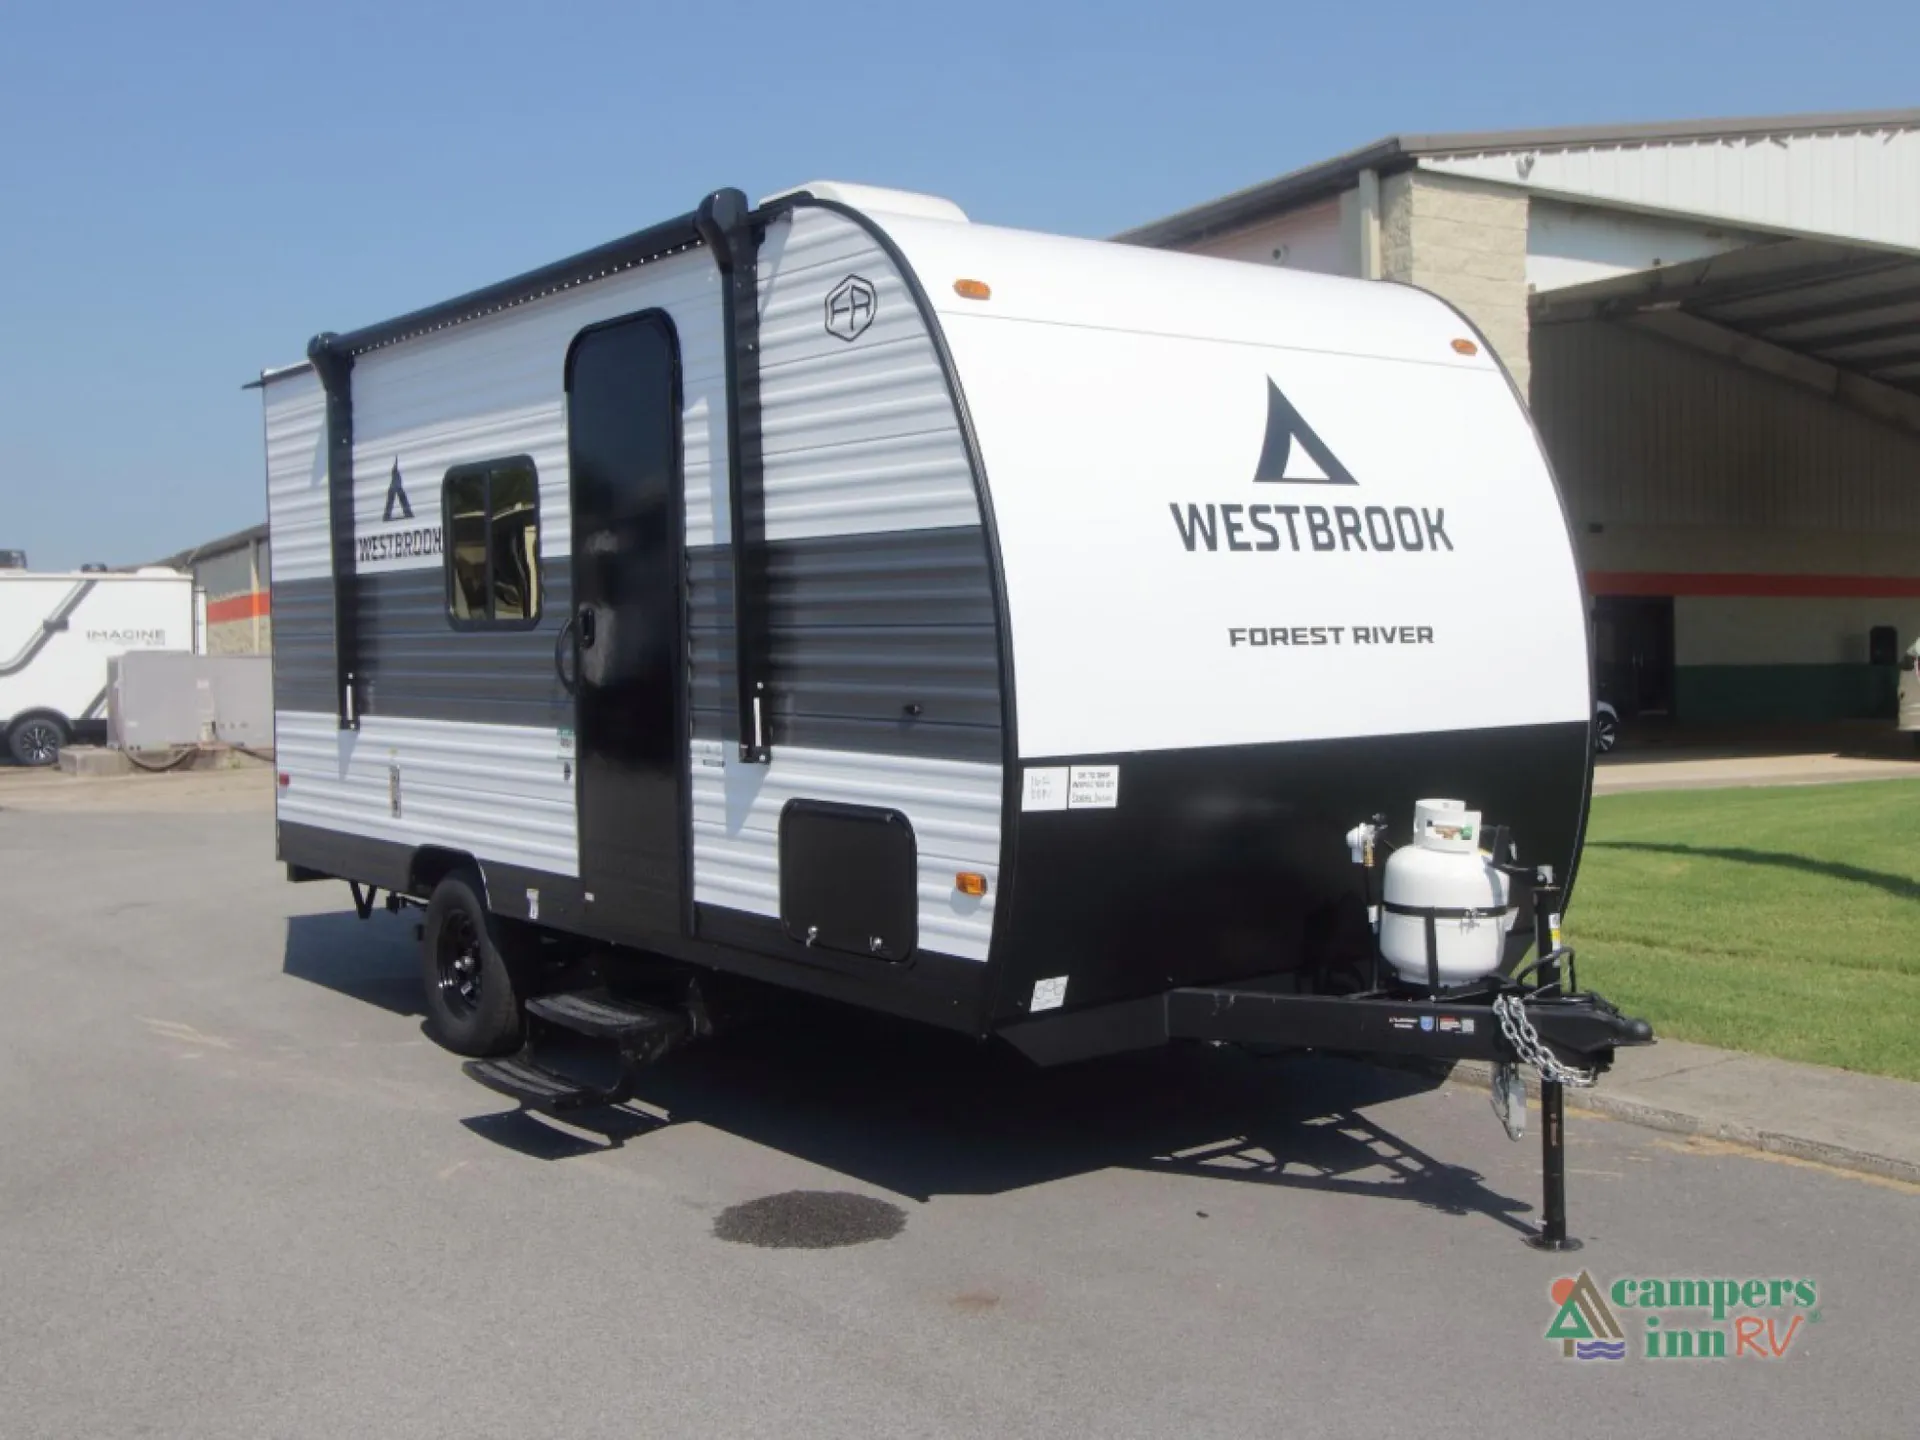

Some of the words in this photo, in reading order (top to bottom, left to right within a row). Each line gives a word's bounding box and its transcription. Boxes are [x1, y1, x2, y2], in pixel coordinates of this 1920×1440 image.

[1169, 502, 1454, 552] WESTBROOK
[358, 527, 443, 562] WESTBROOK
[86, 628, 165, 641] IMAGINE
[1228, 627, 1345, 647] FOREST
[1352, 626, 1435, 645] RIVER
